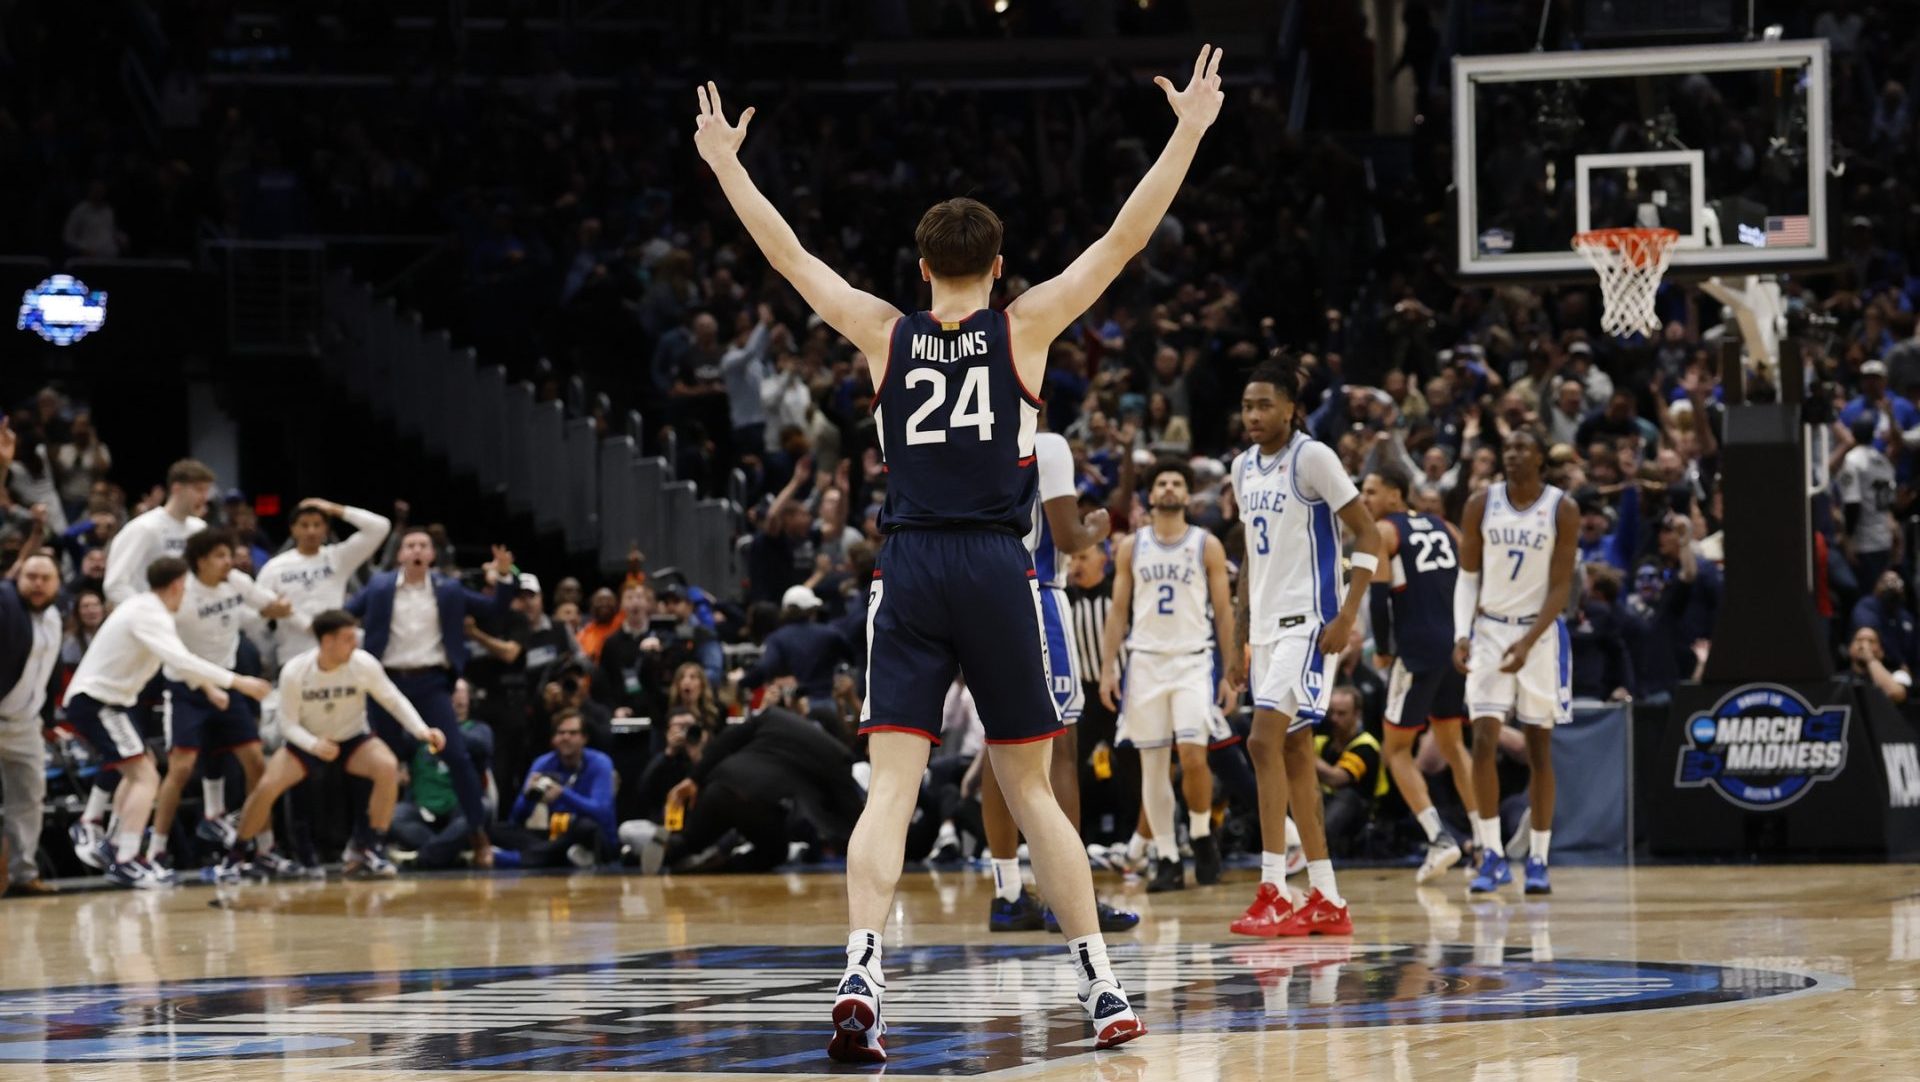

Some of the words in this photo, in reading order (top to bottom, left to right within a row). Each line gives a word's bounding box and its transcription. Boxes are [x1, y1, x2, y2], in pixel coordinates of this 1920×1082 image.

[911, 330, 988, 363] MULLINS
[905, 366, 995, 446] 24
[1253, 516, 1270, 555] 3
[1488, 528, 1547, 550] DUKE
[1408, 531, 1456, 573] 23
[1508, 550, 1524, 581] 7
[1139, 563, 1195, 585] DUKE
[1158, 584, 1174, 615] 2
[1715, 716, 1803, 744] MARCH
[1726, 741, 1842, 770] MADNESS
